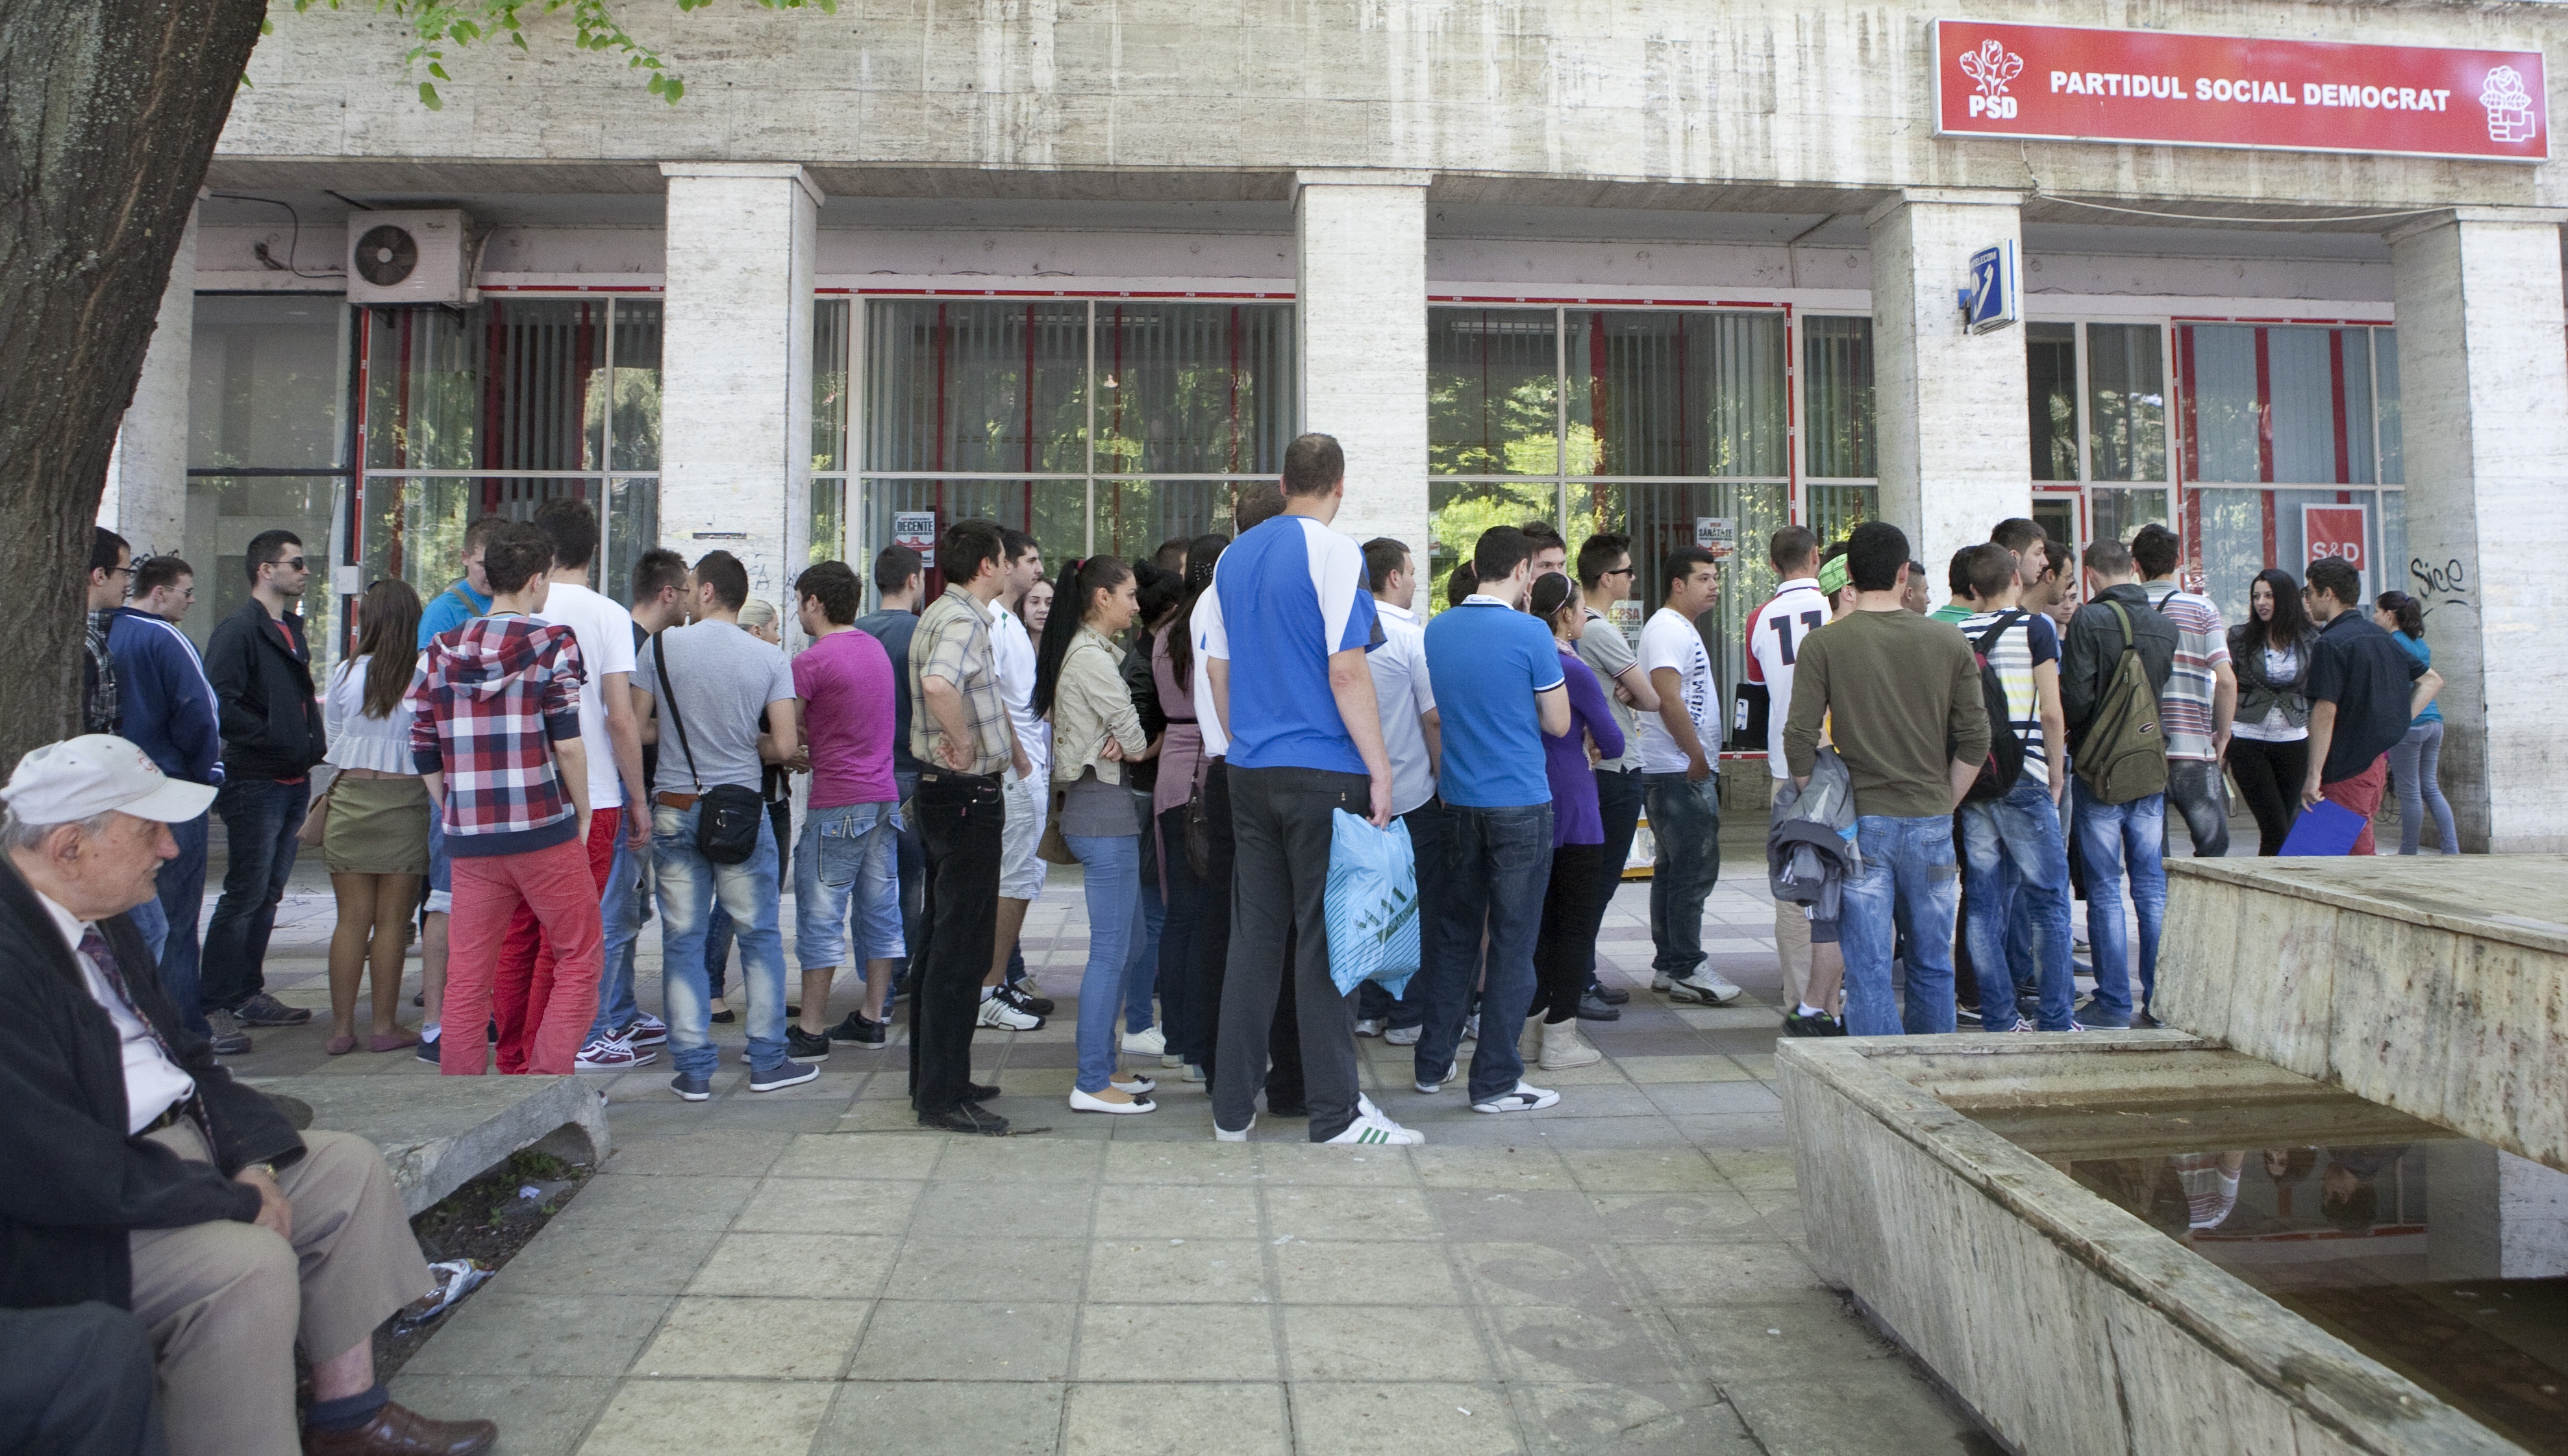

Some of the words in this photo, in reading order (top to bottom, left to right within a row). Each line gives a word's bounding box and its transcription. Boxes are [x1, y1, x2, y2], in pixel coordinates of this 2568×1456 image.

[2050, 70, 2188, 99] PARTIDUL
[2195, 77, 2296, 105] SOCIAL
[2303, 82, 2450, 112] DEMOCRAT
[1969, 95, 2017, 119] PSD
[897, 521, 933, 532] DECENTE
[2312, 541, 2360, 561] S&D
